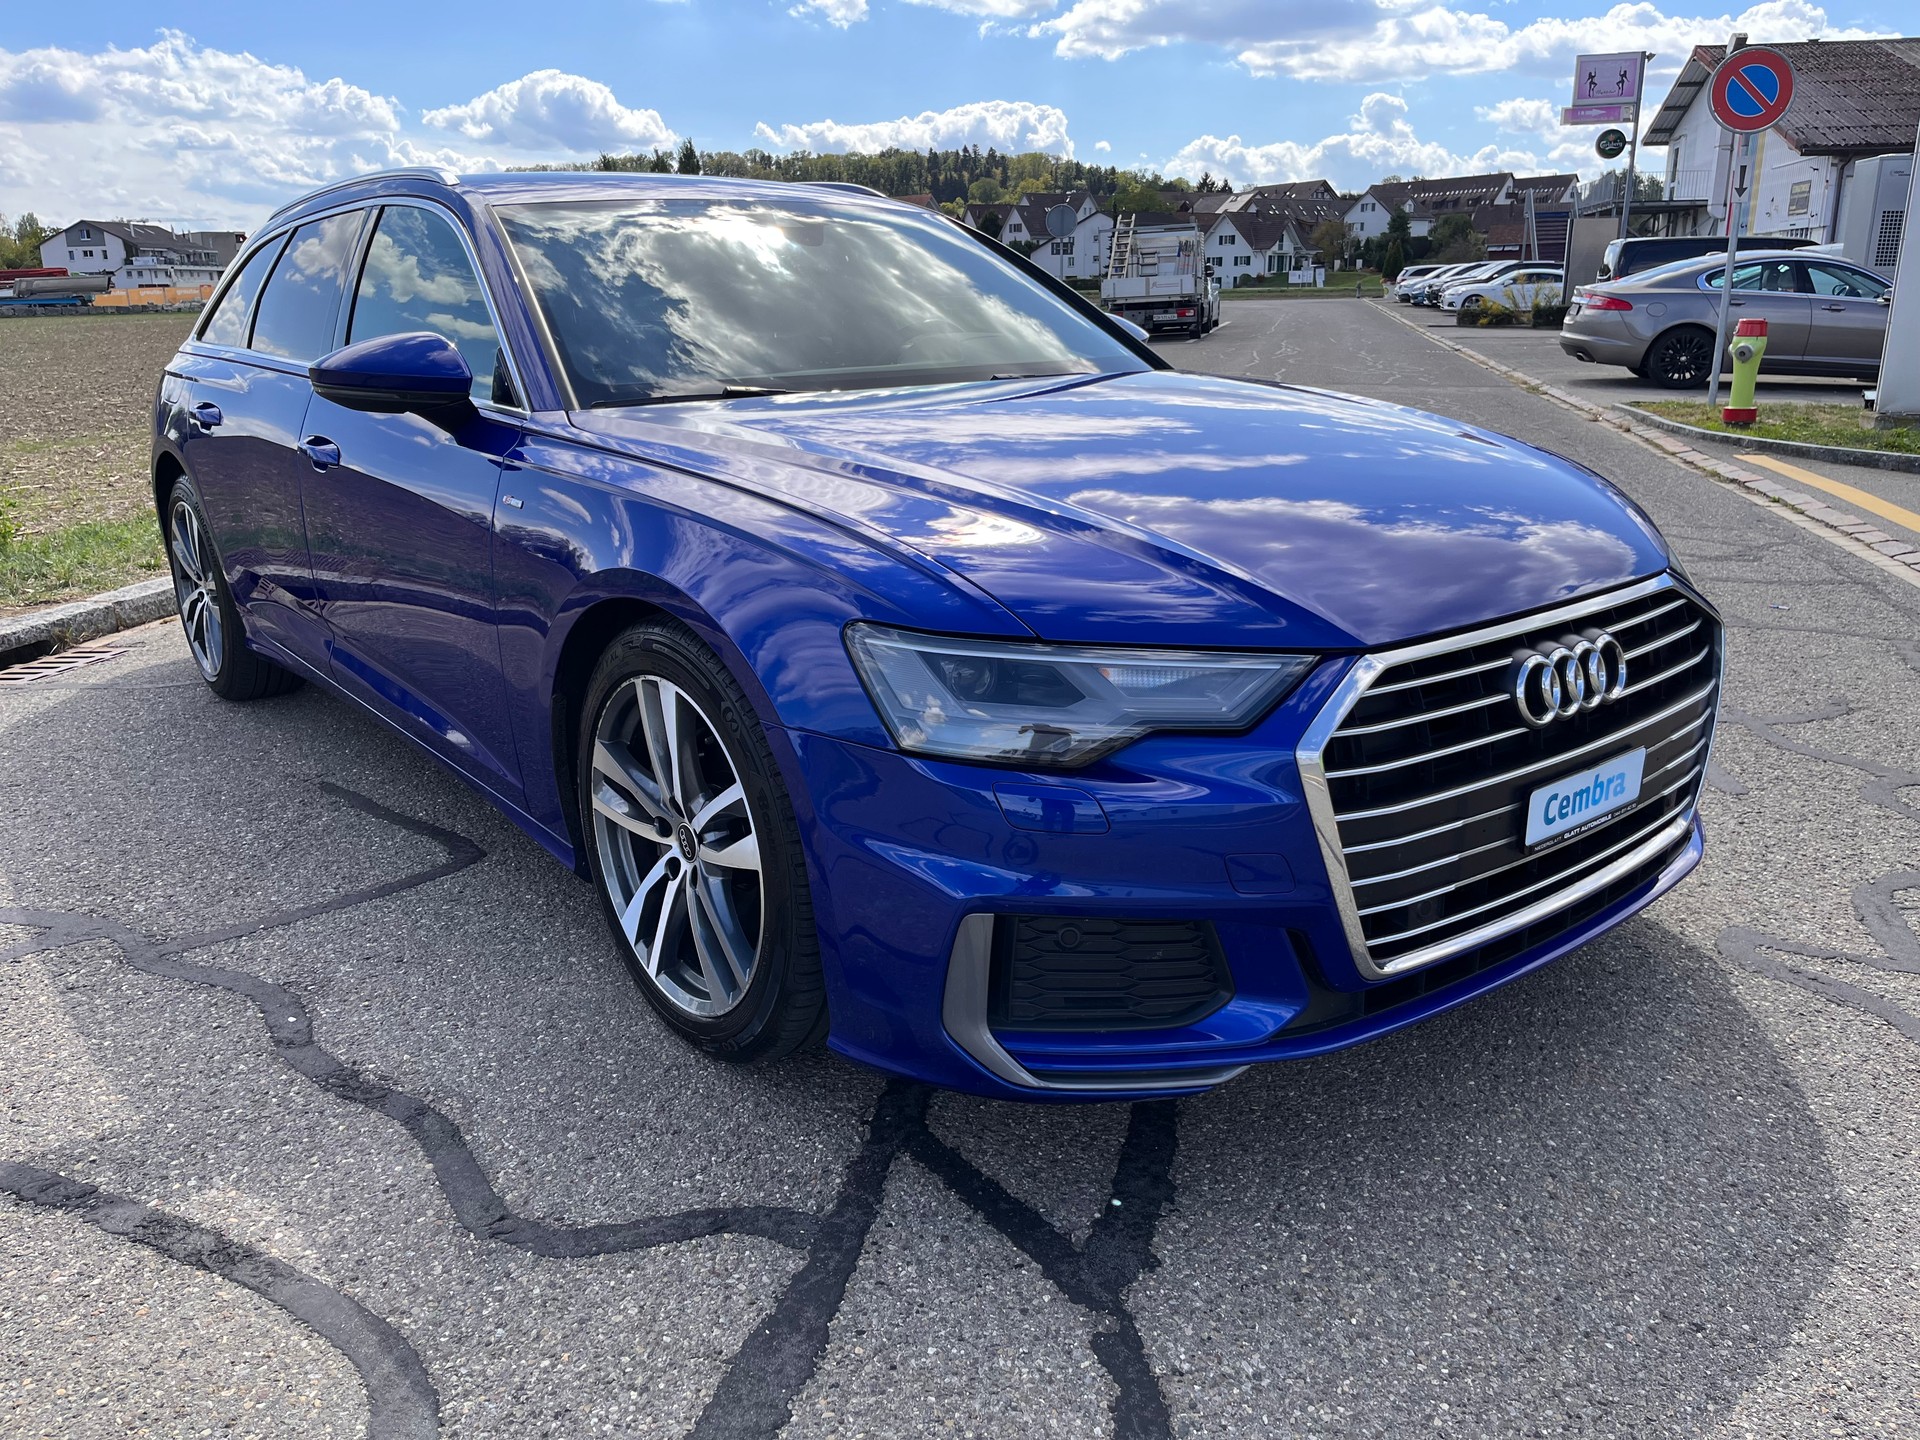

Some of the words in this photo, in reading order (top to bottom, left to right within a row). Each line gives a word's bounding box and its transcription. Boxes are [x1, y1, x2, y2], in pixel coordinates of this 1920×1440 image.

[1599, 140, 1623, 150] Carlsberg
[1543, 772, 1626, 826] Cembra
[1563, 827, 1581, 839] GLATT
[1580, 813, 1612, 833] AUTOMOBILE
